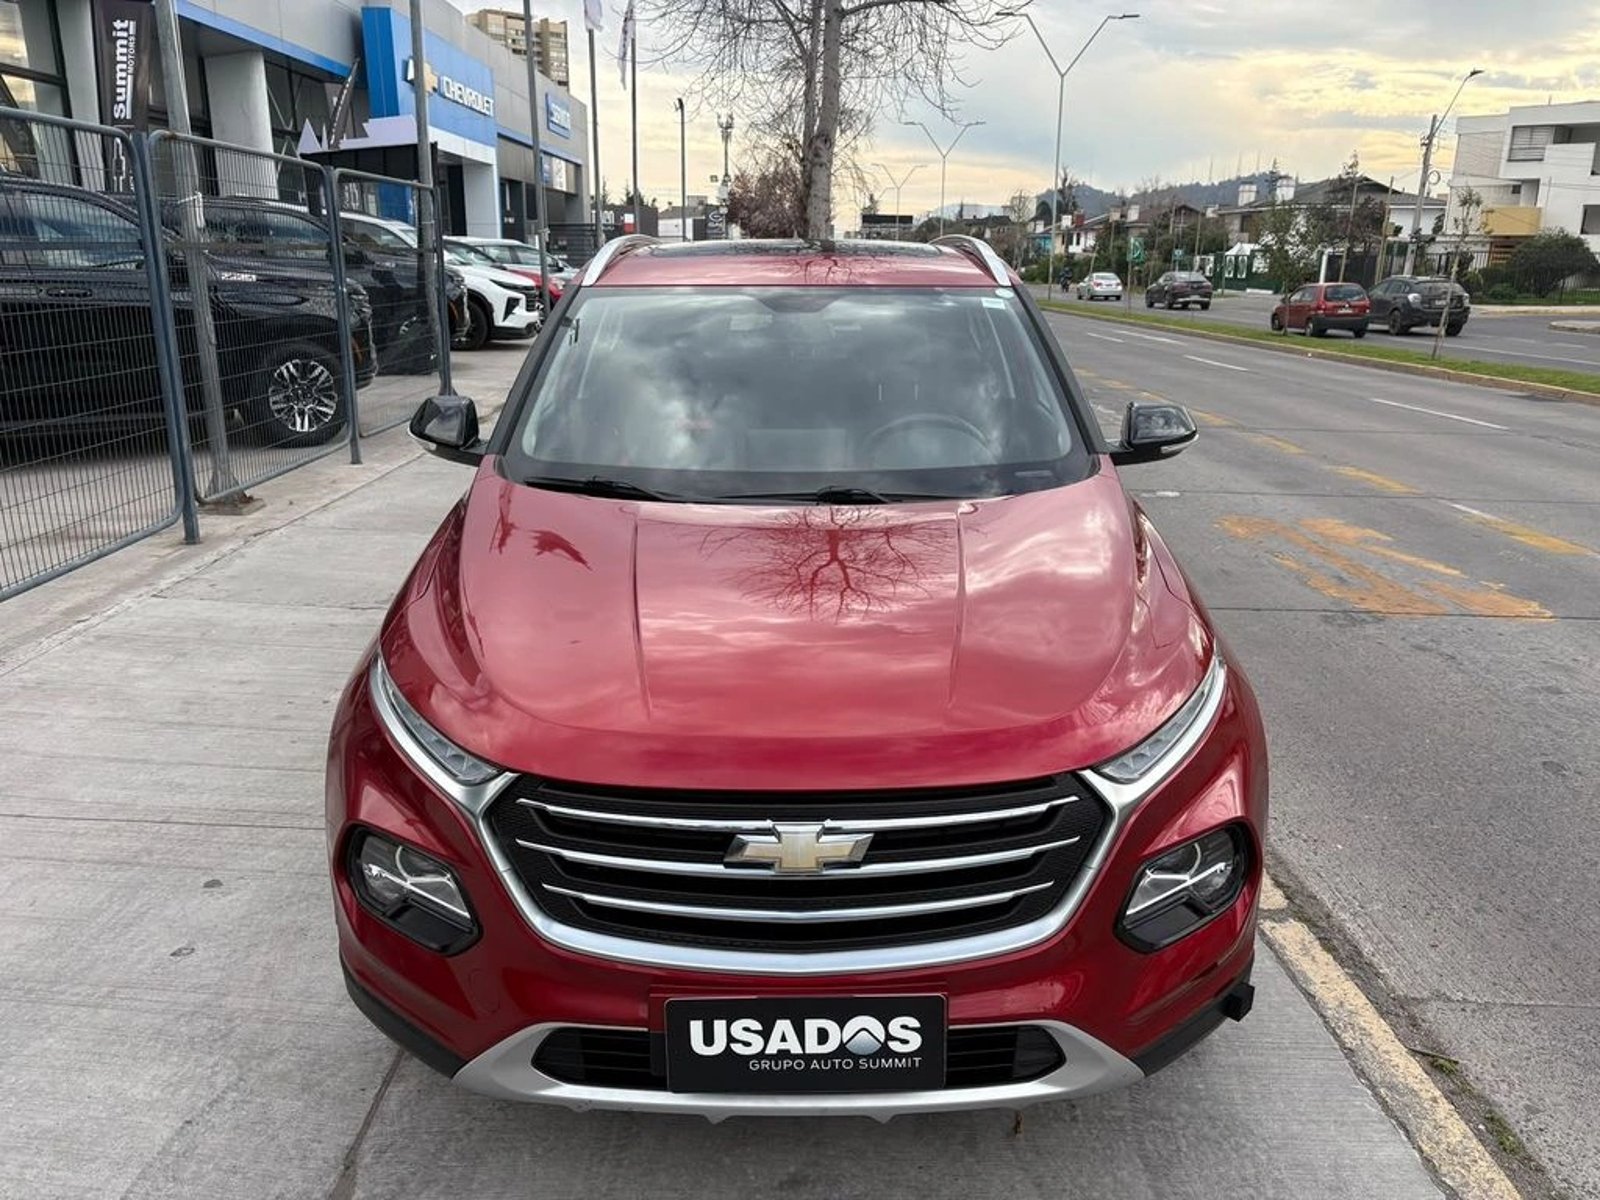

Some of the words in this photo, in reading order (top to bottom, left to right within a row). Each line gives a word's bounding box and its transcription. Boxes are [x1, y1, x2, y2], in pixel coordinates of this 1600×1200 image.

[113, 19, 129, 119] Summit
[127, 36, 136, 74] MOTORS
[441, 75, 494, 117] CHEVROLET
[689, 1015, 923, 1056] USADOS
[749, 1059, 805, 1071] GRUPO
[810, 1058, 854, 1070] AUTO
[859, 1057, 922, 1070] SUMMIT
